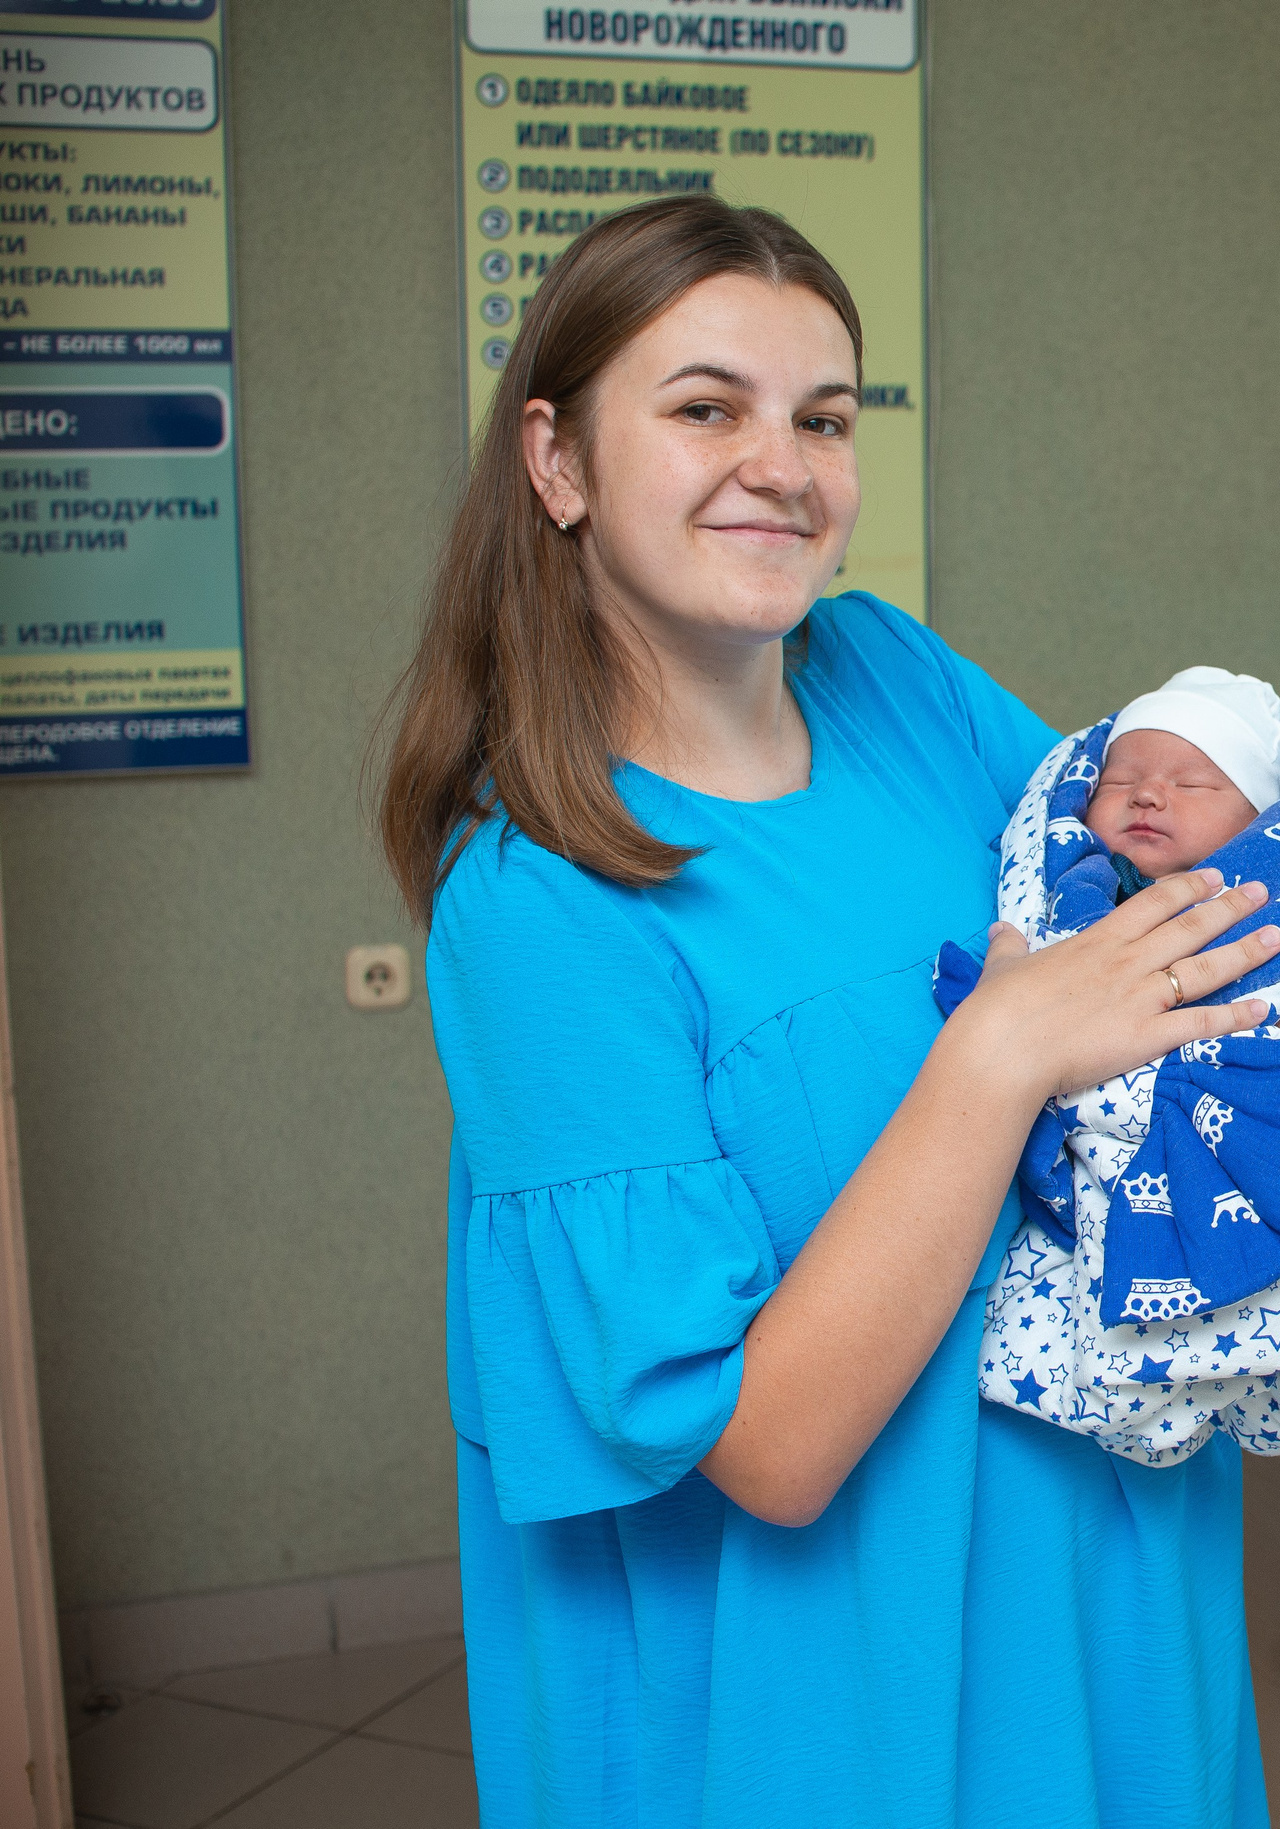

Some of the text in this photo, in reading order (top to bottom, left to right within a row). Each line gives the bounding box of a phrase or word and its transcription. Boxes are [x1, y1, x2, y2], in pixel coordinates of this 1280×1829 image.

[545, 8, 846, 53] НОВОРОЖДЕННОГО
[17, 82, 206, 113] ПРОДУКТОВ
[515, 77, 615, 107] ОДЕЯЛО
[622, 77, 748, 112] БАЙКОВОЕ
[516, 121, 875, 162] ИЛИ ШЕРСТЯНОЕ (ПО СЕЗОНУ)
[0, 172, 220, 198] ОКИ, ЛИМОНЫ,
[517, 164, 714, 194] ПОДОДЕЯЛЬНИК
[67, 204, 187, 227] БАНАНЫ
[518, 209, 608, 236] РАСПА
[0, 265, 166, 287] НЕРАЛЬНАЯ
[21, 334, 51, 355] НЕ
[56, 334, 127, 355] БОЛЕЕ
[134, 334, 189, 355] 1000
[0, 409, 79, 438] ЕНО:
[50, 497, 219, 524] ПРОДУКТЫ
[18, 619, 165, 647] ИЗДЕЛИЯ
[123, 716, 242, 741] ОТДЕЛЕНИЕ
